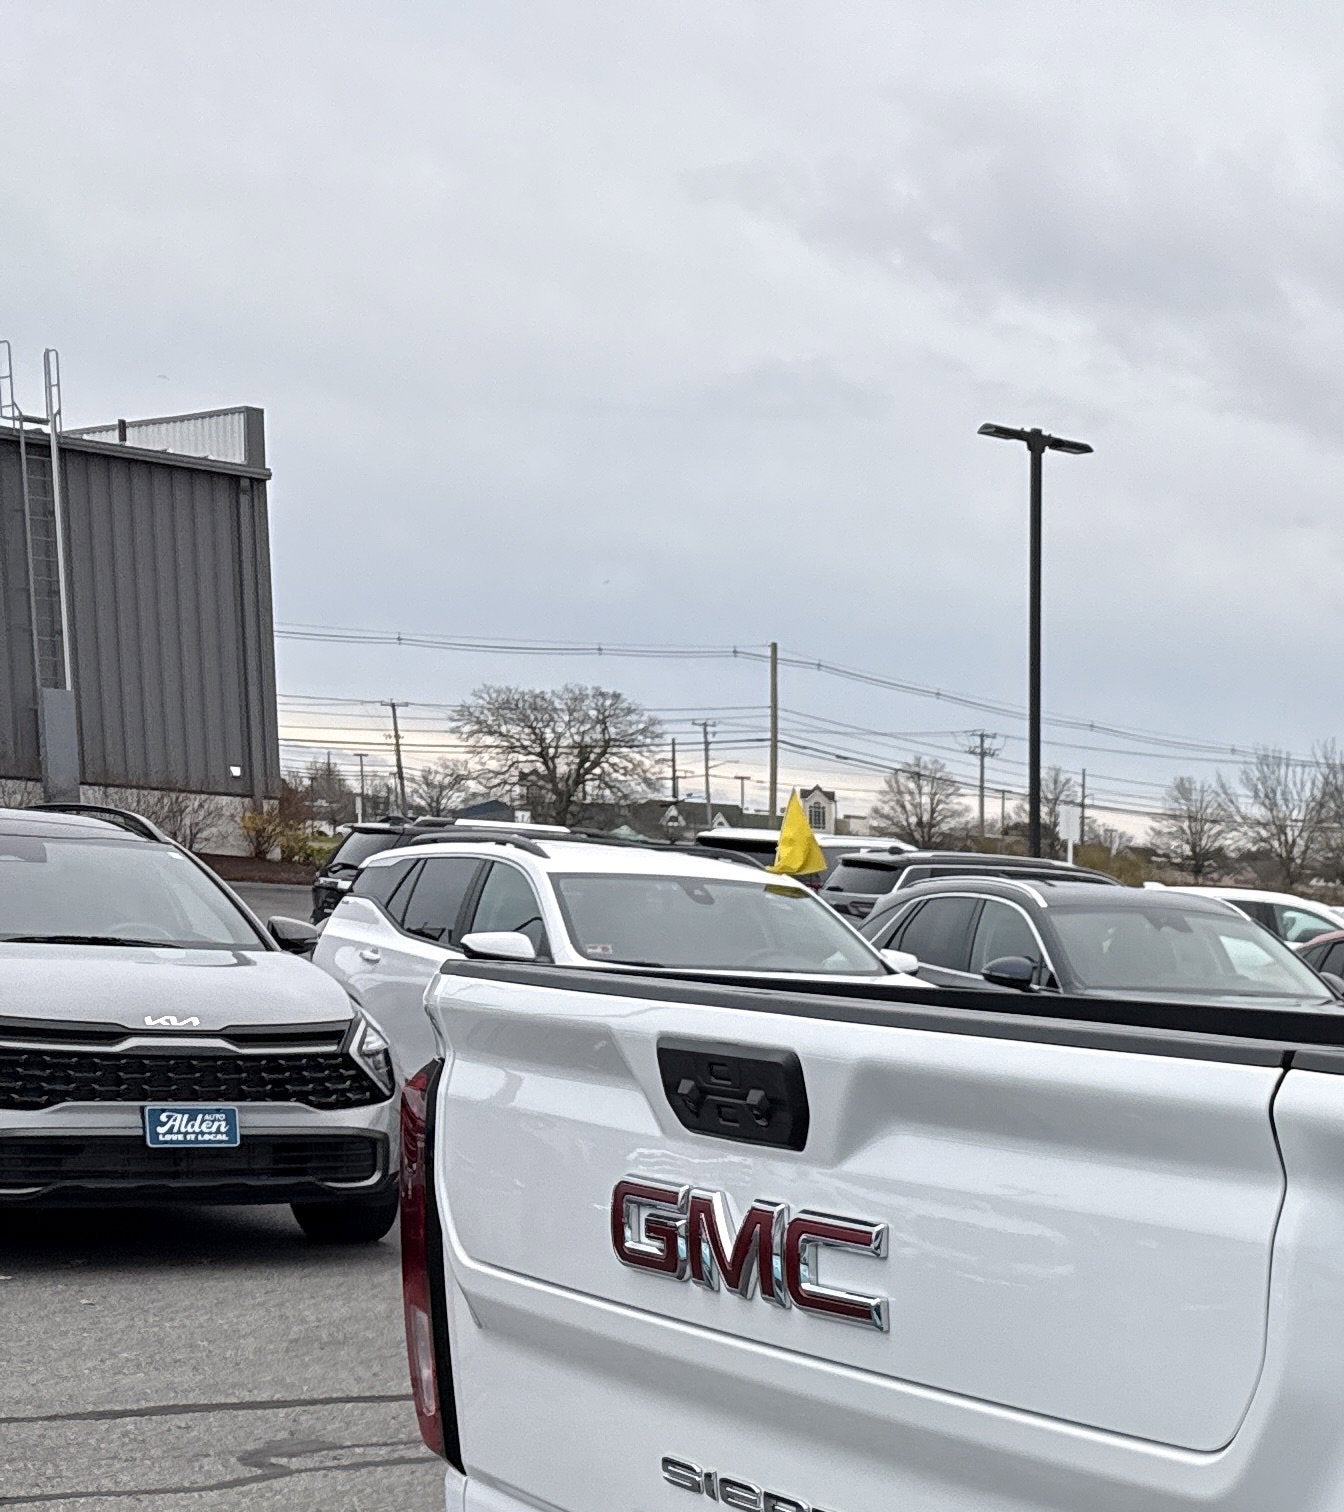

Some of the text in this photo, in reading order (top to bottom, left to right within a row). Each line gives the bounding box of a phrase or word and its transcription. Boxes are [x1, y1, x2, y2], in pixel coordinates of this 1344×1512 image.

[156, 1111, 229, 1134] Alden
[203, 1113, 226, 1121] AUTO
[158, 1133, 230, 1141] LOVE IT LOCAL
[611, 1173, 890, 1333] GMC
